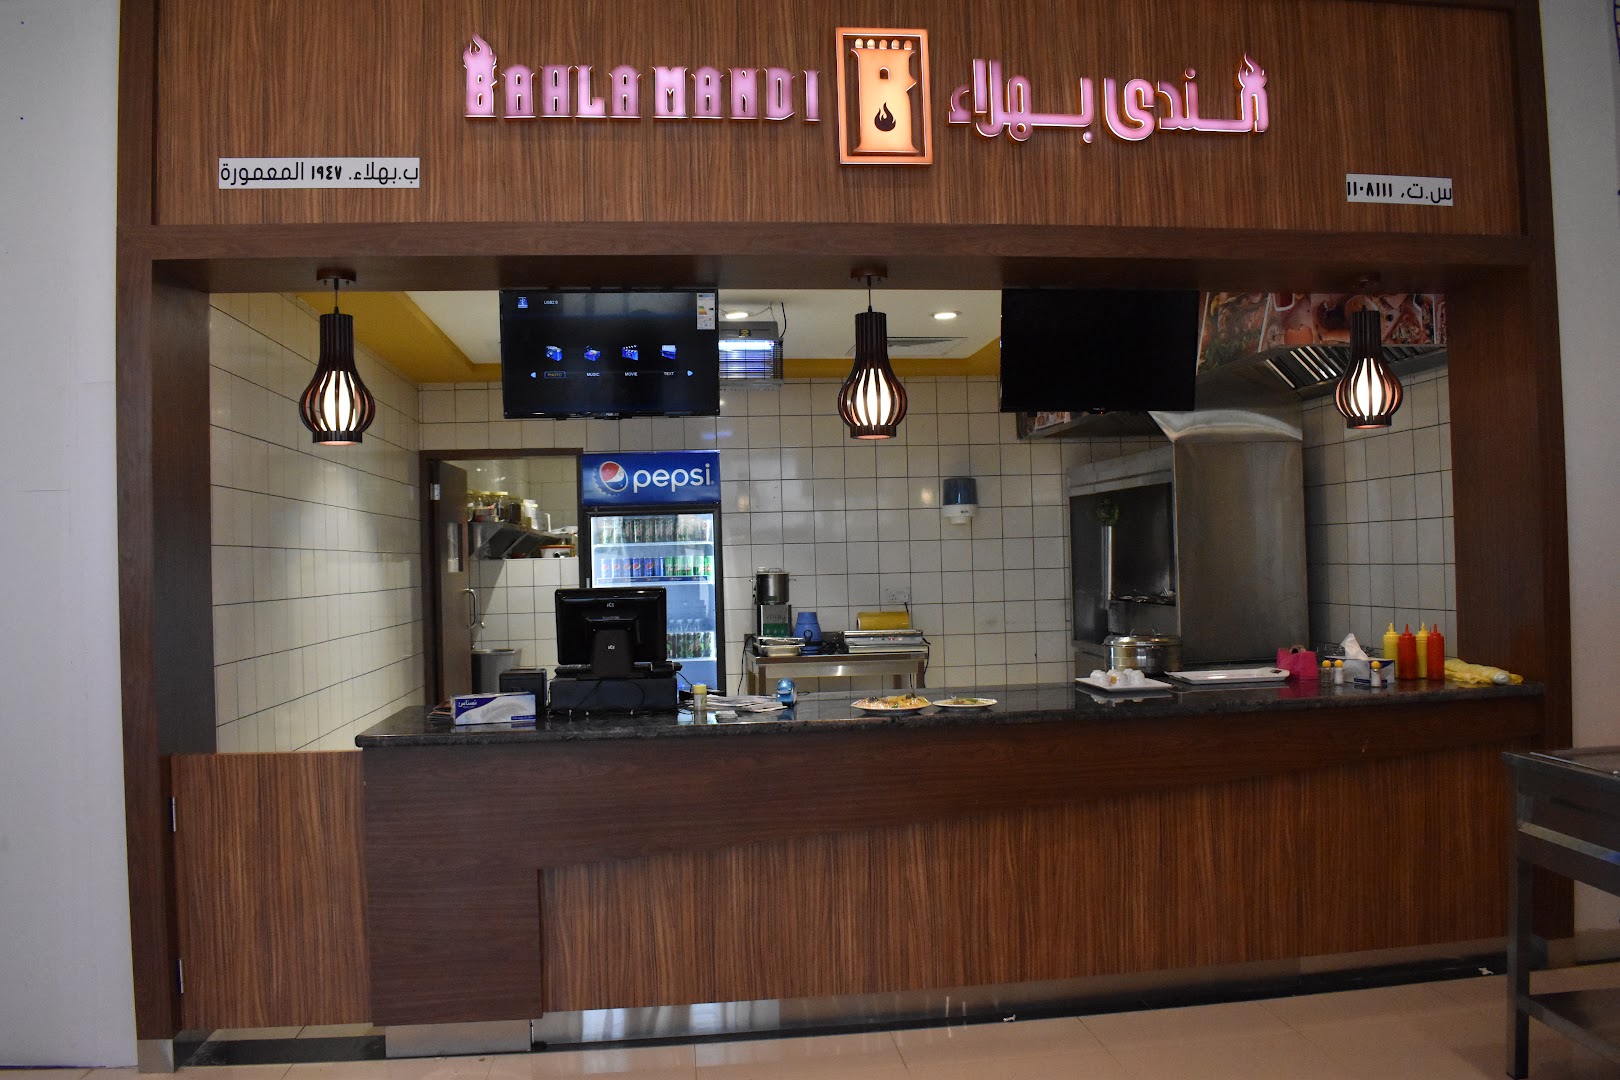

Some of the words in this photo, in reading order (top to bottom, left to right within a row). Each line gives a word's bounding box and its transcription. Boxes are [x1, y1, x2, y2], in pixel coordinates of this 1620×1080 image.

[463, 32, 642, 119] BAHLA
[651, 64, 821, 122] MANDI
[947, 58, 1095, 146] بهلاء
[220, 161, 304, 185] المعمورة
[311, 165, 342, 180] ١٩٤٧
[633, 463, 711, 494] pepsi
